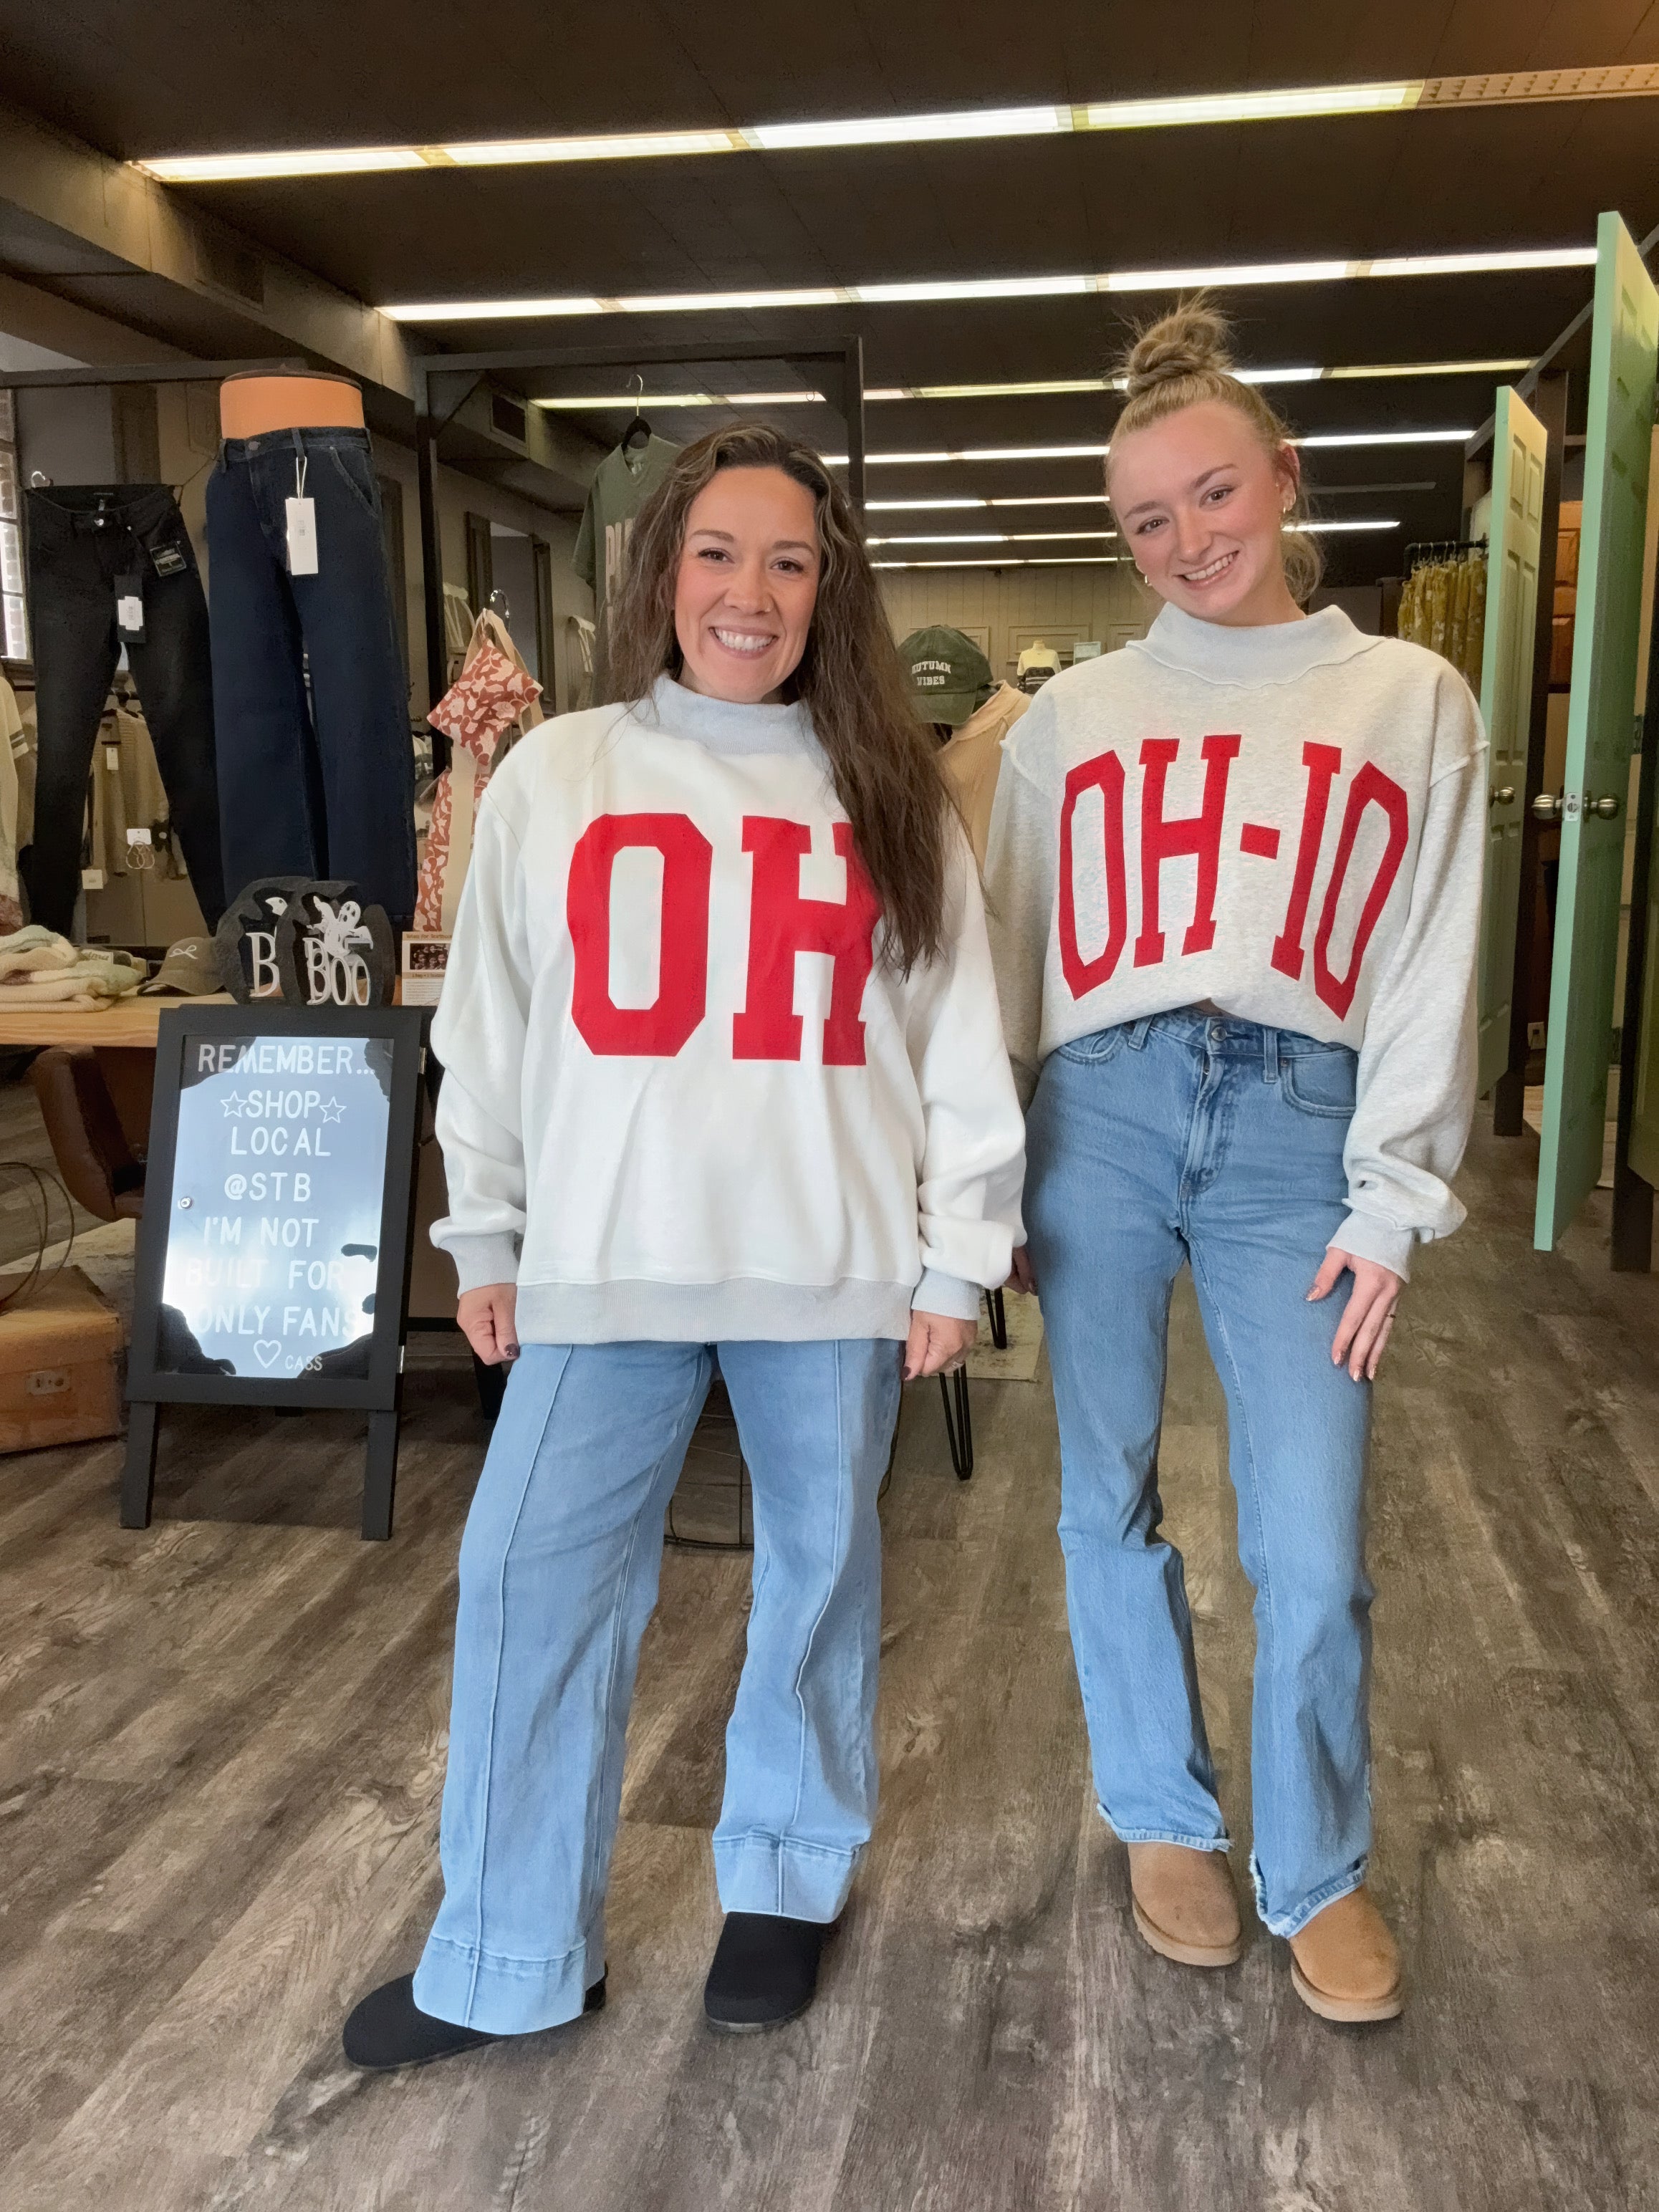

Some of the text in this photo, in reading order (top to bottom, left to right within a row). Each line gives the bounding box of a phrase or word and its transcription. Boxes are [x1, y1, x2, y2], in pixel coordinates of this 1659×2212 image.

[911, 660, 951, 674] AUTUMN
[916, 675, 945, 686] VIBES
[567, 812, 885, 1067] OH
[306, 938, 370, 1006] BOO
[198, 1044, 376, 1074] REMEMBER...
[246, 1090, 321, 1119] SHOP
[230, 1126, 332, 1157] LOCAL
[224, 1172, 311, 1202] @STB
[203, 1216, 319, 1247] I'M NOT
[288, 1260, 345, 1290] FOR
[196, 1303, 358, 1339] ONLY FANS
